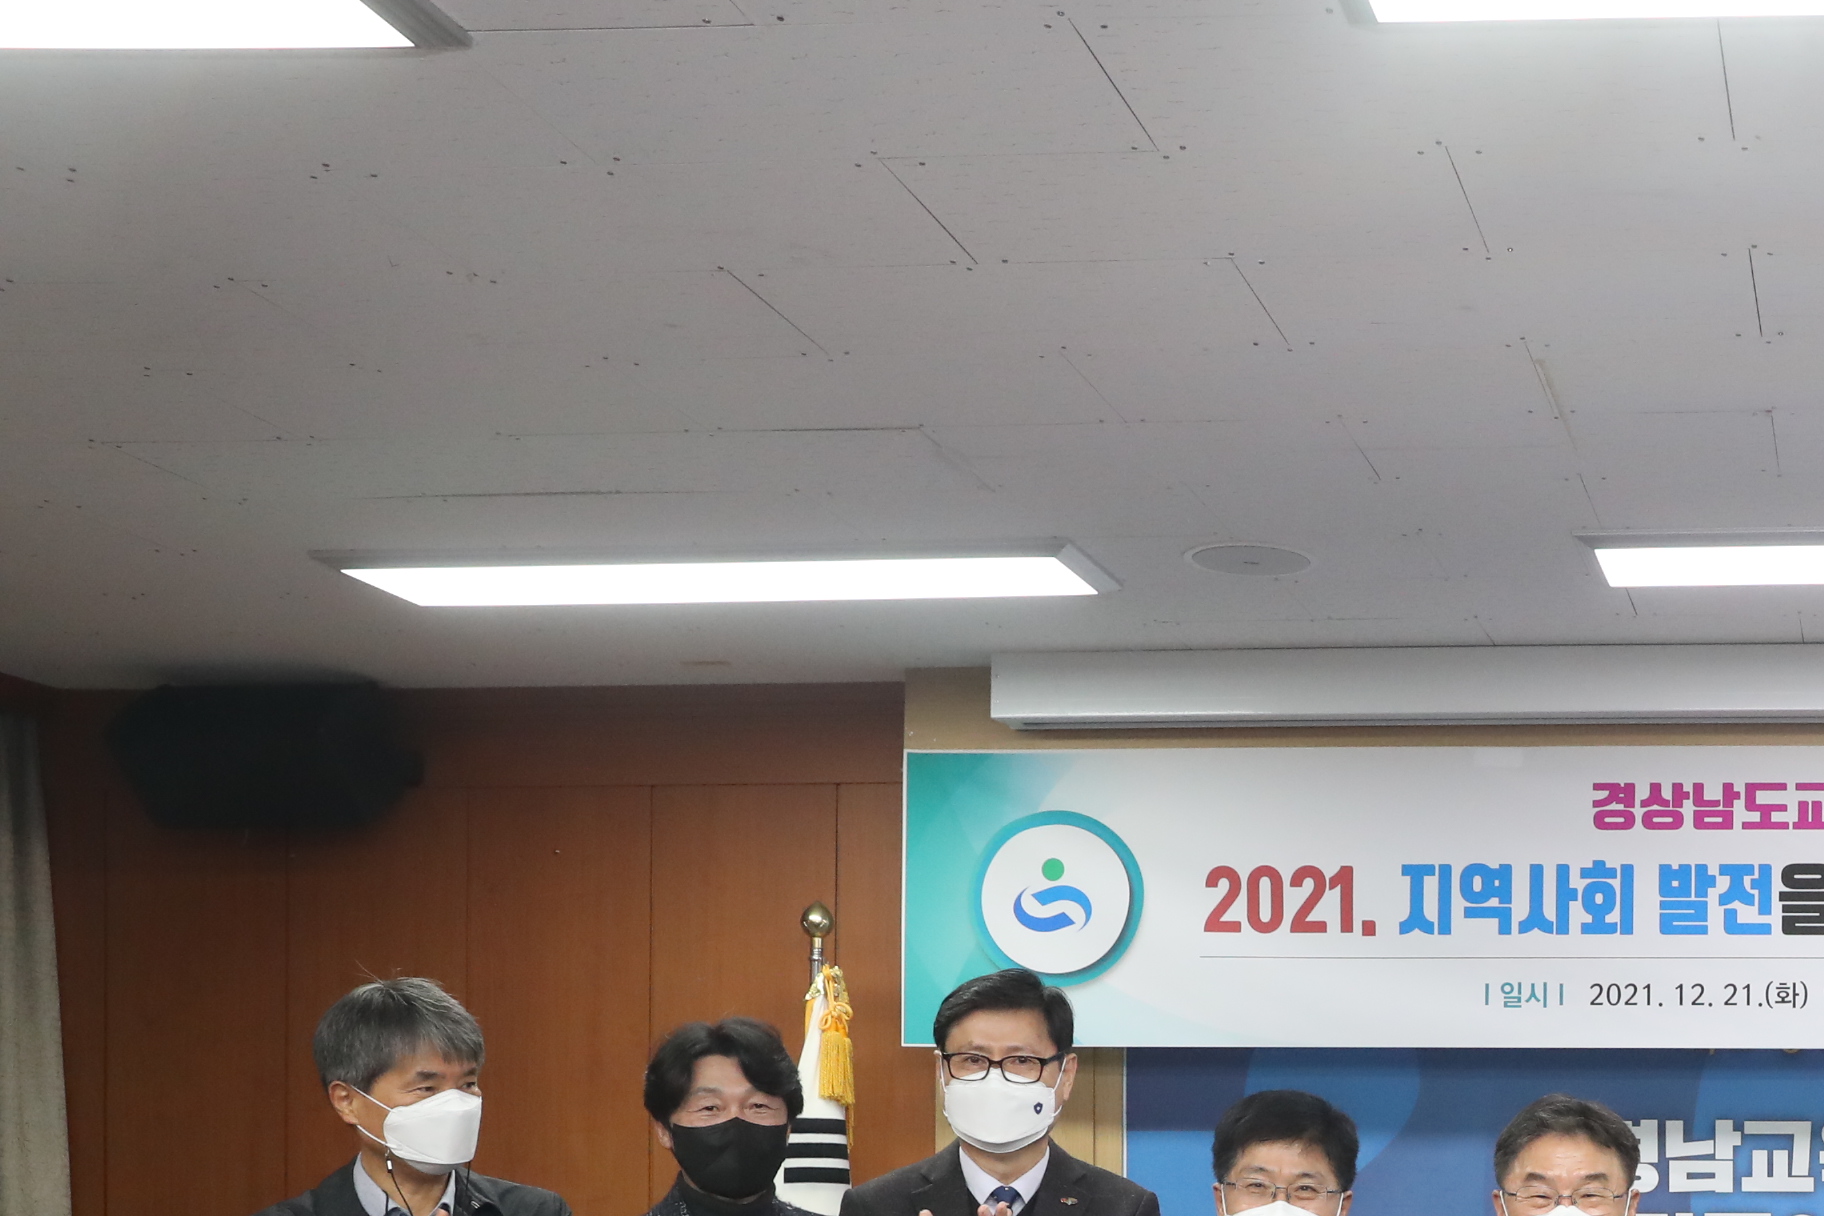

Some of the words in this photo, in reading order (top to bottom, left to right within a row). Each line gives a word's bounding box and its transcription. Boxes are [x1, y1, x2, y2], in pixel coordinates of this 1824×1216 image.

[1203, 864, 1376, 936] 2021.
[1398, 859, 1634, 936] 지역사회
[1499, 981, 1547, 1008] 일시
[1589, 982, 1663, 1007] 2021.
[1674, 983, 1712, 1007] 12.
